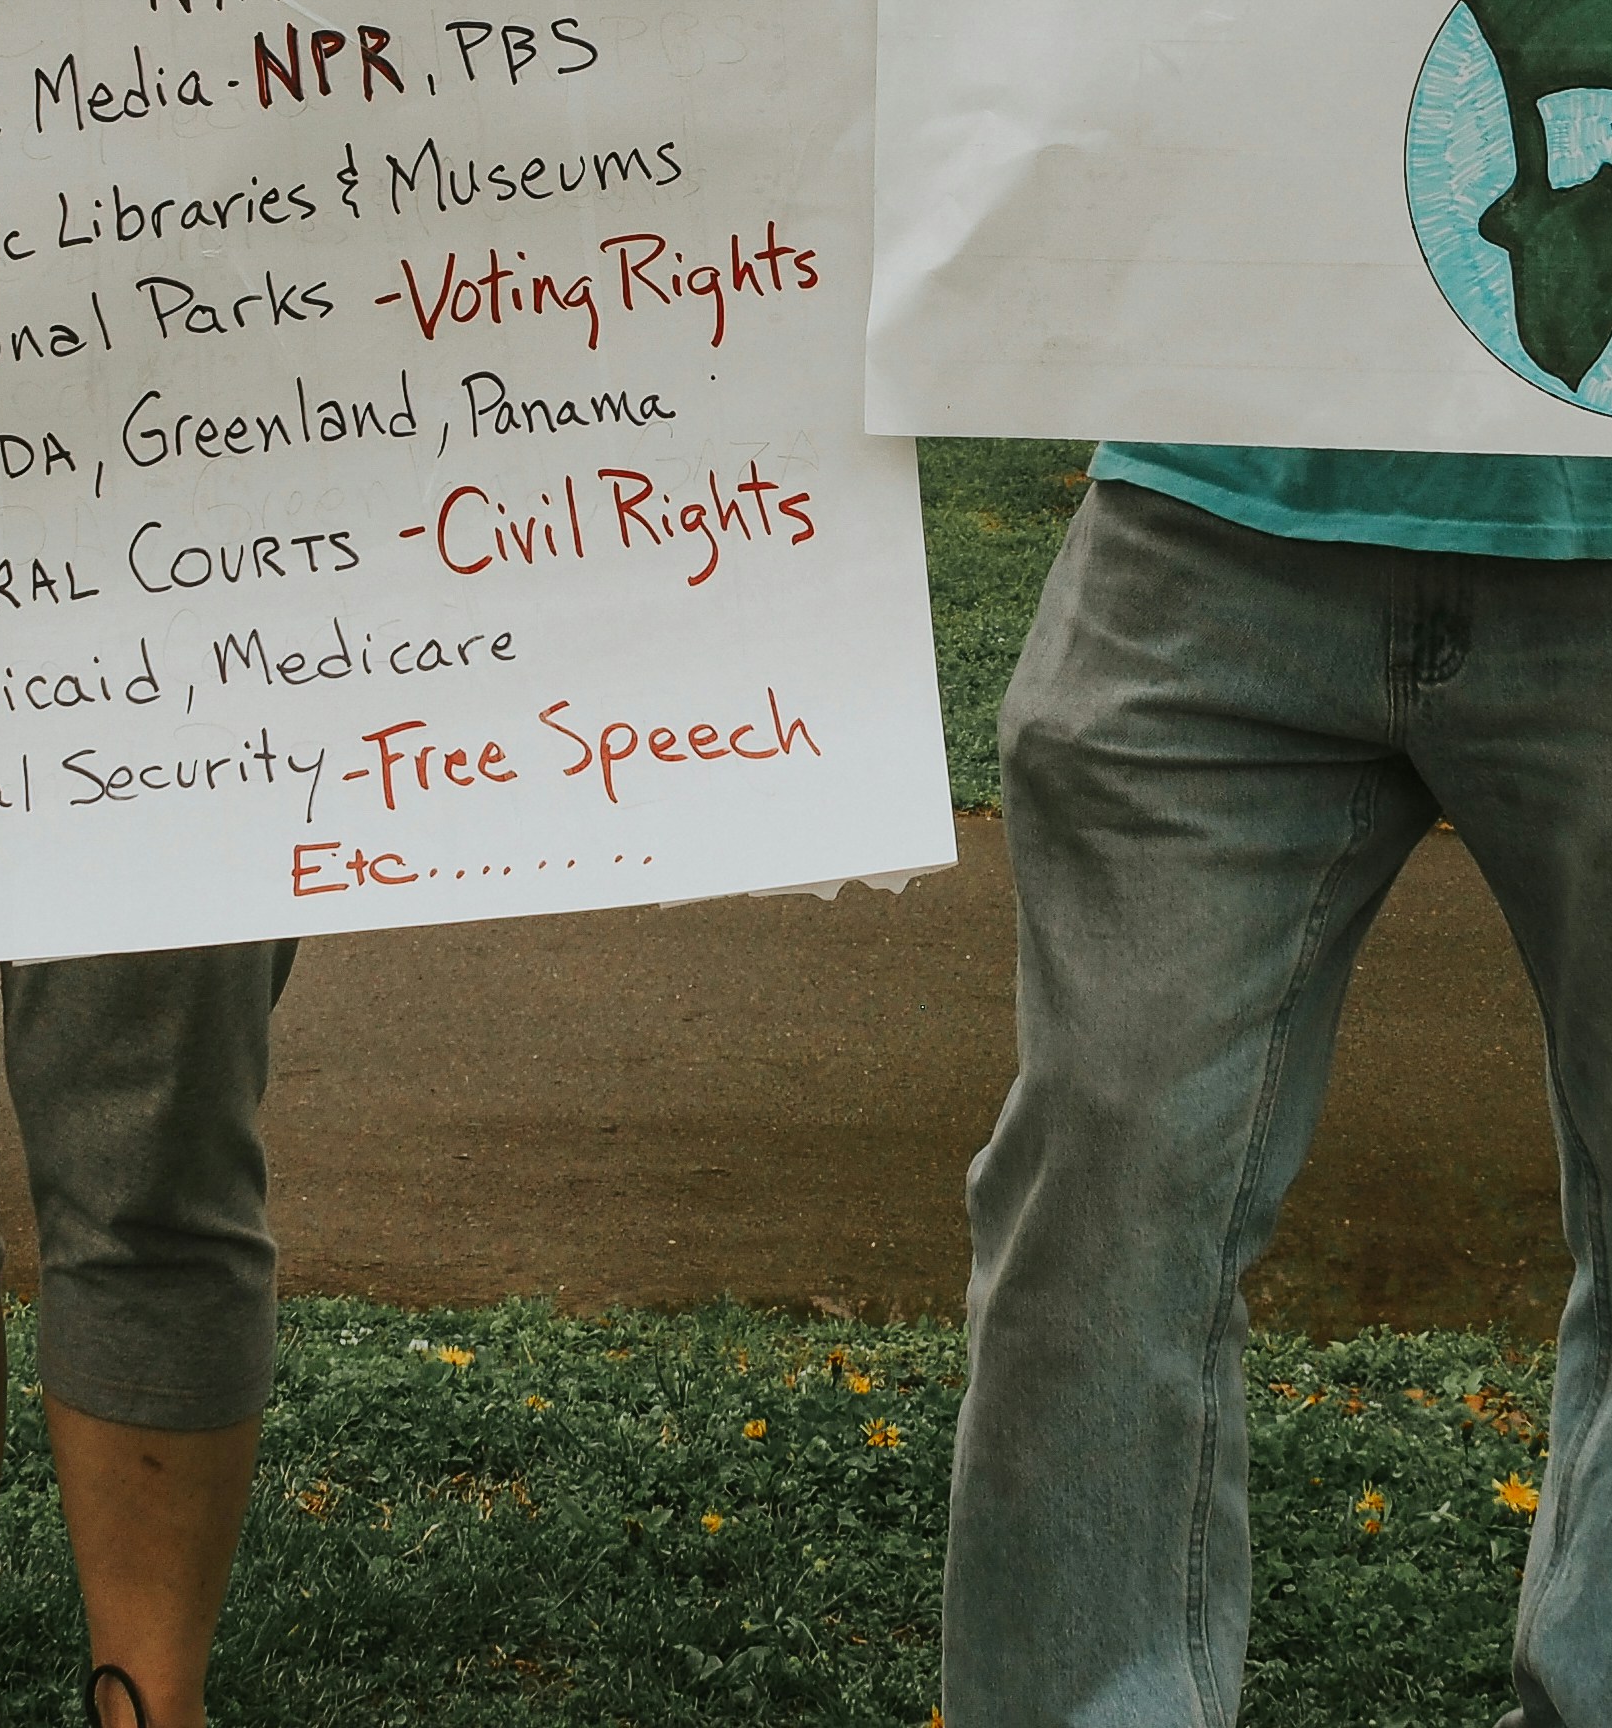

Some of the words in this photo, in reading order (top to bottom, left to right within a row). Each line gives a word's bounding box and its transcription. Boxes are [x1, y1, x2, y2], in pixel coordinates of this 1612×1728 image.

[445, 11, 598, 85] PBS
[58, 175, 317, 261] Libraries
[386, 138, 682, 224] Museums
[135, 269, 334, 339] Parks
[620, 221, 818, 348] Rights
[461, 371, 676, 438] Panama
[129, 521, 360, 593] COURTS
[598, 469, 814, 586] Rights
[213, 617, 516, 685] Medicare
[62, 727, 325, 823] Security
[538, 687, 821, 804] Speech
